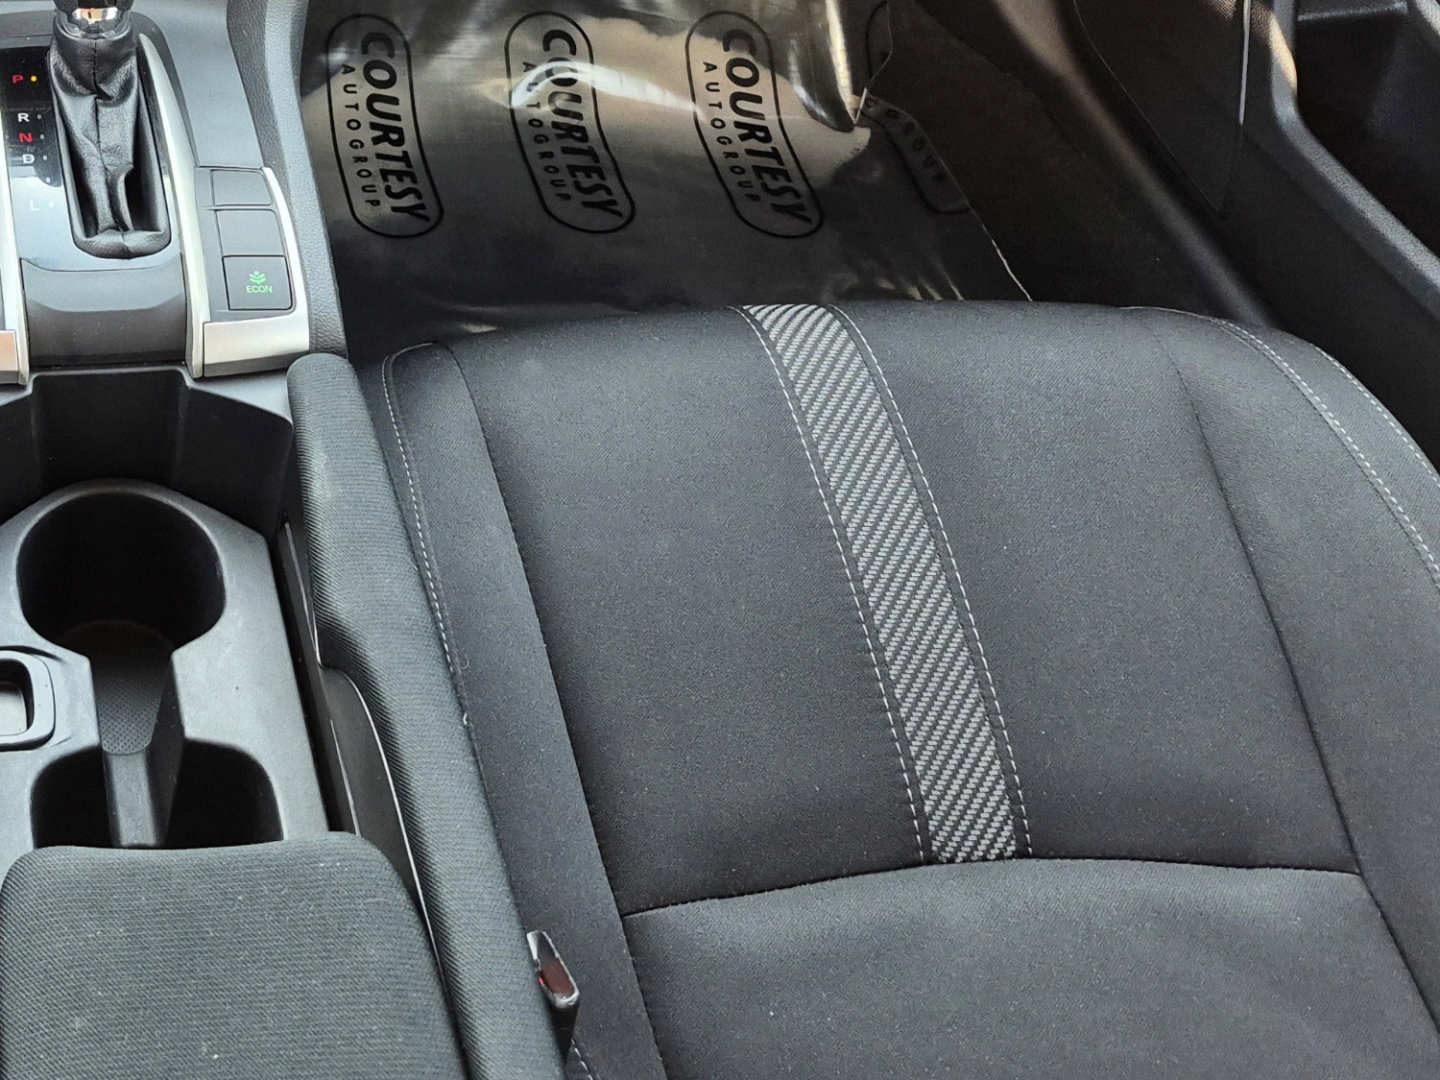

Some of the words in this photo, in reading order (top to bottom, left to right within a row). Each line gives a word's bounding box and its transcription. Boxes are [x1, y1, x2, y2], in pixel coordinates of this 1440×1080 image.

[12, 74, 24, 83] P
[17, 112, 30, 122] R
[361, 32, 431, 222] COURTESY
[542, 29, 624, 218] COURTESY
[722, 28, 812, 224] COURTESY
[18, 132, 34, 142] N
[340, 63, 382, 208] AUTOGROUP
[702, 61, 761, 203] AUTOGROUP
[22, 153, 35, 164] D
[29, 199, 40, 211] L
[246, 285, 272, 293] ECON
